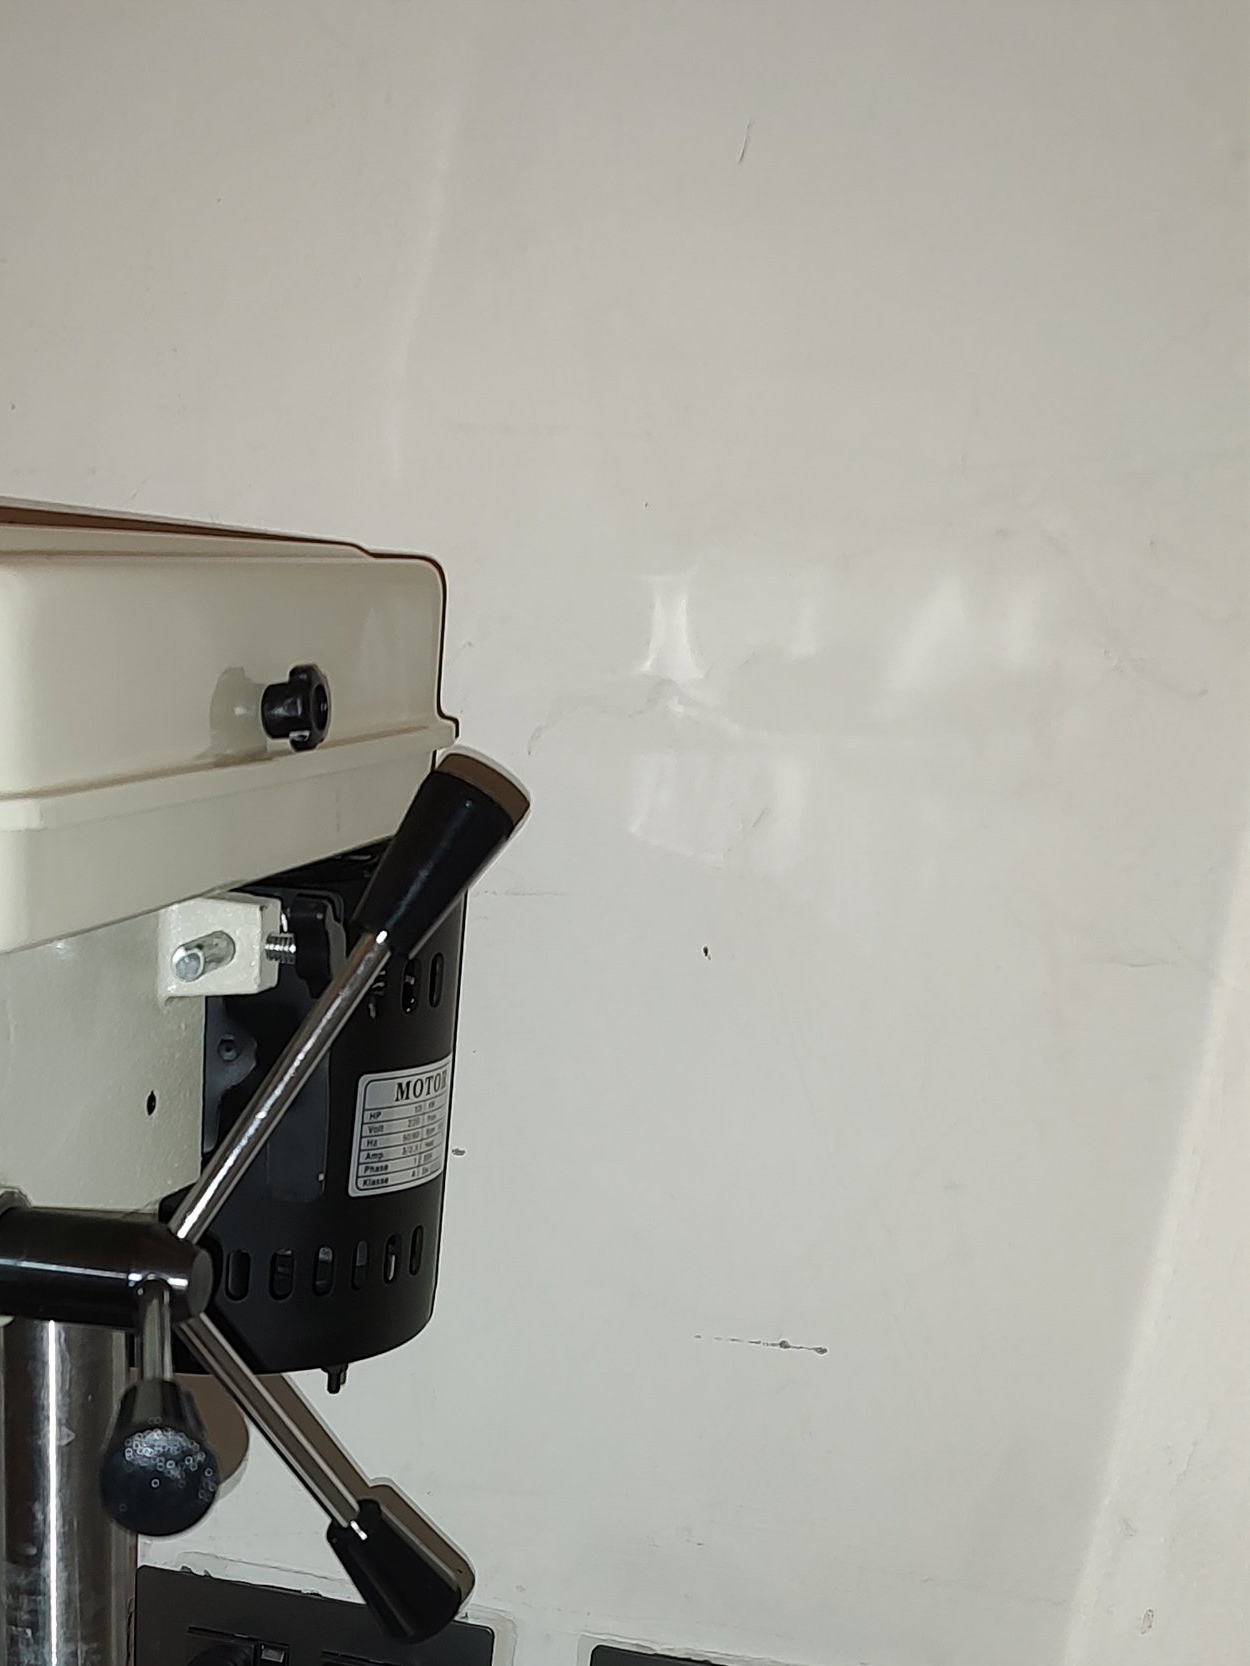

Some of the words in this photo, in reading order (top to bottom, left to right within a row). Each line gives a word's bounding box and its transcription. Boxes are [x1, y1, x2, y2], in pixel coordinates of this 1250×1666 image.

[369, 1111, 382, 1120] HP
[368, 1124, 384, 1134] Volt
[365, 1151, 384, 1161] Amp
[363, 1164, 389, 1174] Phase
[362, 1176, 390, 1187] Klasse
